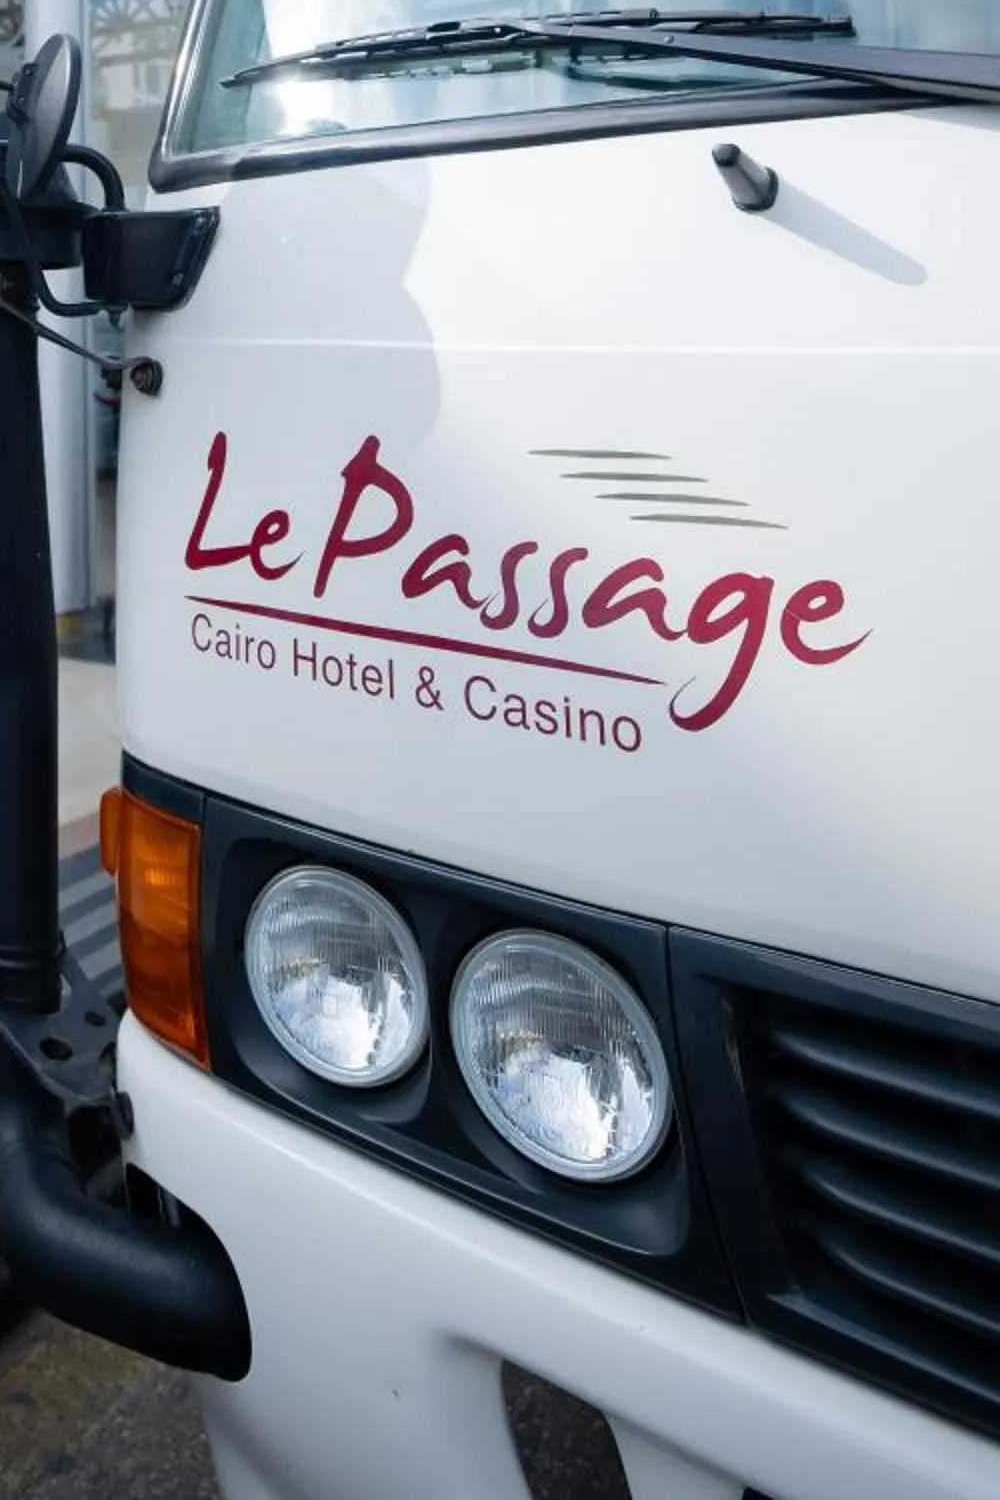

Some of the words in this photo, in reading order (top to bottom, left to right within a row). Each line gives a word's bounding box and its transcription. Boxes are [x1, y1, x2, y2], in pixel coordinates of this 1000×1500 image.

[185, 431, 304, 581] Le
[313, 434, 874, 732] Passage
[190, 613, 276, 670] Cairo
[293, 638, 395, 700] Hotel
[415, 666, 444, 710] &
[464, 675, 643, 753] Casino
